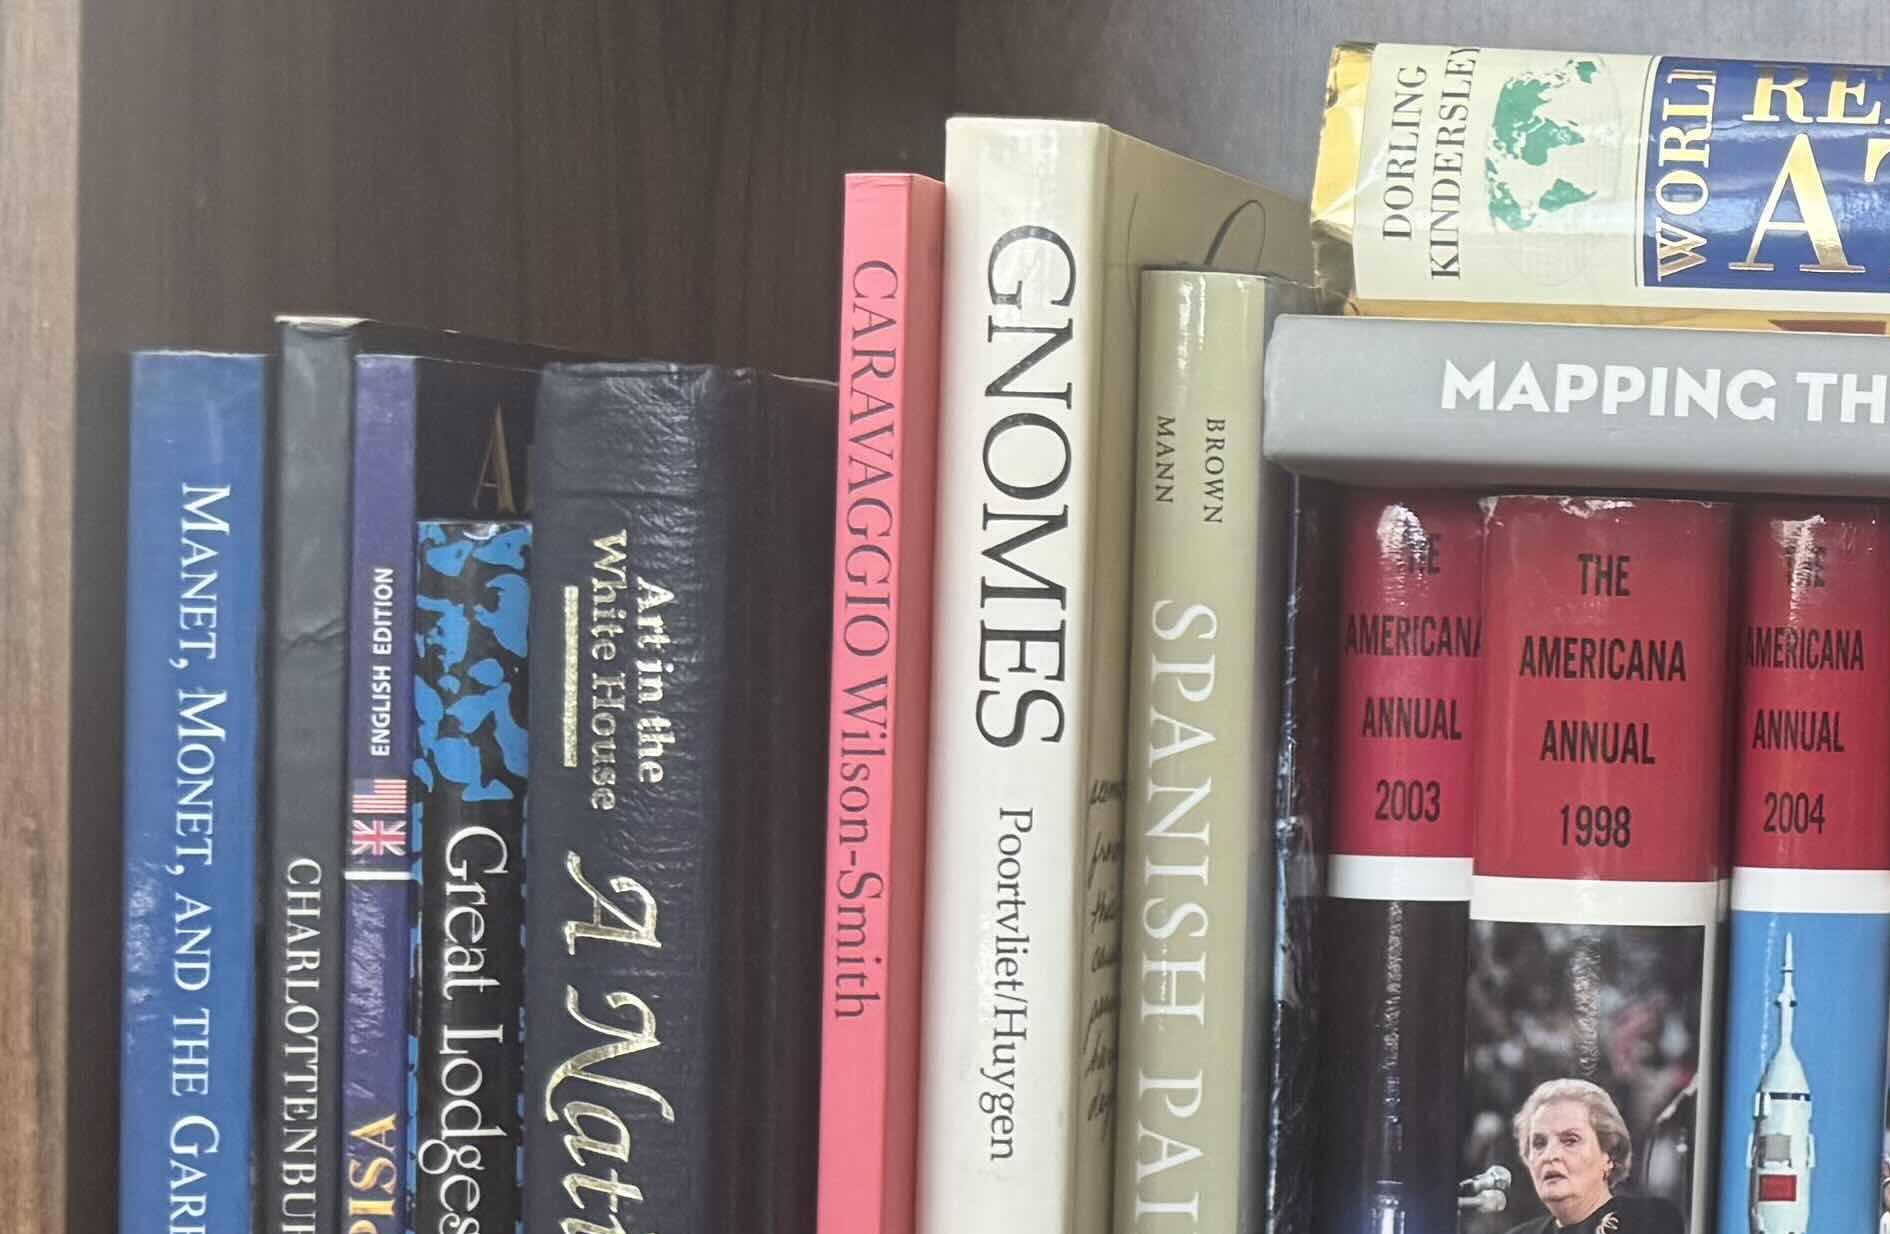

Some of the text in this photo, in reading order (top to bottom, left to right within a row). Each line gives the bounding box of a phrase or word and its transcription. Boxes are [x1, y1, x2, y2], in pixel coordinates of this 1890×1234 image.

[1382, 65, 1427, 239] DORLING
[1441, 360, 1775, 422] MAPPING
[1155, 415, 1175, 504] MANN
[1205, 418, 1224, 524] BROWN
[1578, 554, 1630, 597] THE
[370, 568, 391, 756] ENGLISH EDITION
[591, 530, 627, 810] White House
[637, 577, 675, 783] Art in the
[834, 259, 899, 1019] CARAVAGGIO Wilson-Smith
[1519, 636, 1687, 682] AMERICANA
[974, 225, 1077, 1161] GNOMES Poortvliet/Huygen
[1540, 720, 1656, 765] ANNUAL
[1139, 601, 1218, 1024] SPANISH
[1560, 806, 1631, 848] 1998
[564, 850, 662, 955] A
